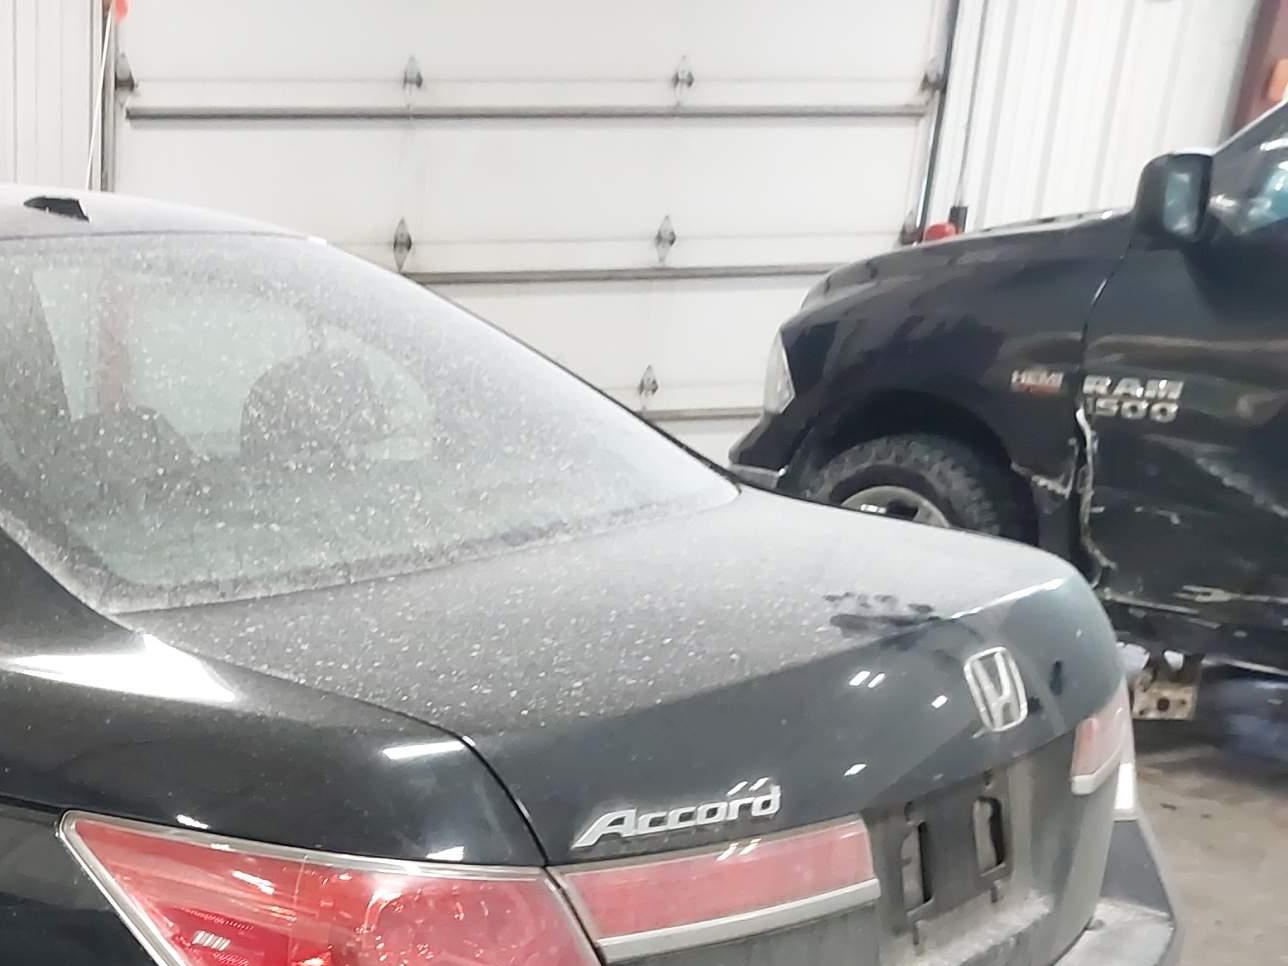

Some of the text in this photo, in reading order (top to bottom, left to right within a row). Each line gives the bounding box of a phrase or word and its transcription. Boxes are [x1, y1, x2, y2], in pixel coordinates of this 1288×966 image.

[1011, 370, 1064, 387] HEMI
[1083, 374, 1184, 399] RAM
[571, 783, 781, 849] Accord
